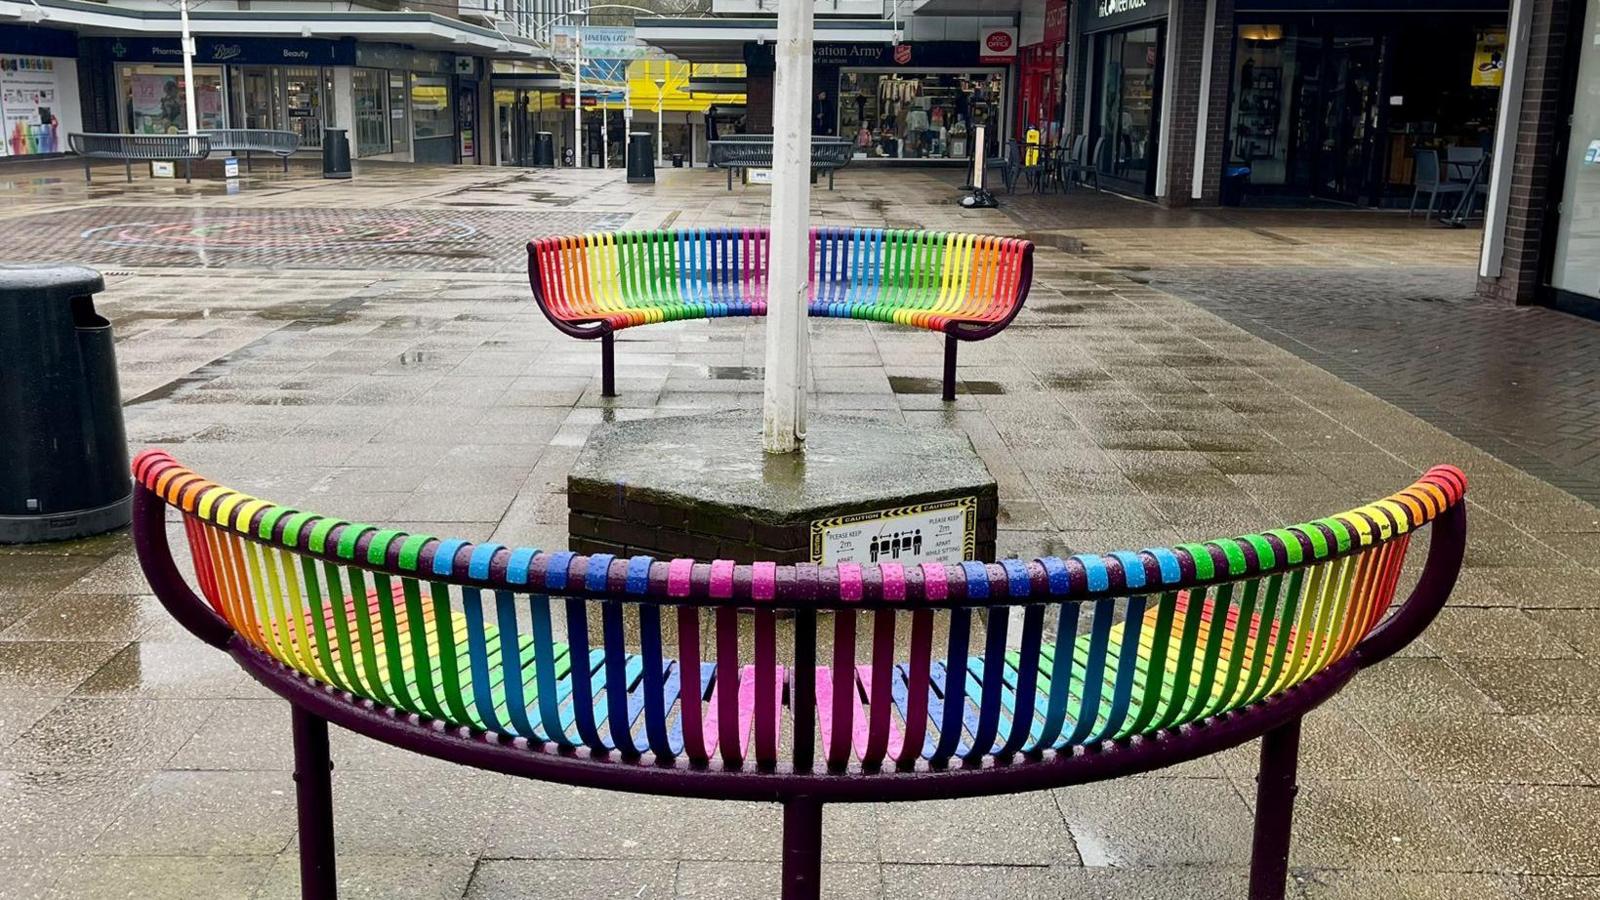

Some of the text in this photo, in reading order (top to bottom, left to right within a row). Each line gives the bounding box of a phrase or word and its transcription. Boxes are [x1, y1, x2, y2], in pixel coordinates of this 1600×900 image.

[283, 48, 309, 59] Beauty
[812, 45, 847, 56] vation
[848, 45, 883, 59] Army
[924, 501, 957, 511] CAUTION
[844, 513, 879, 523] CAUTION
[929, 516, 947, 524] PLEASE
[829, 530, 862, 540] PLEASE KEEP
[840, 541, 852, 549] 2m
